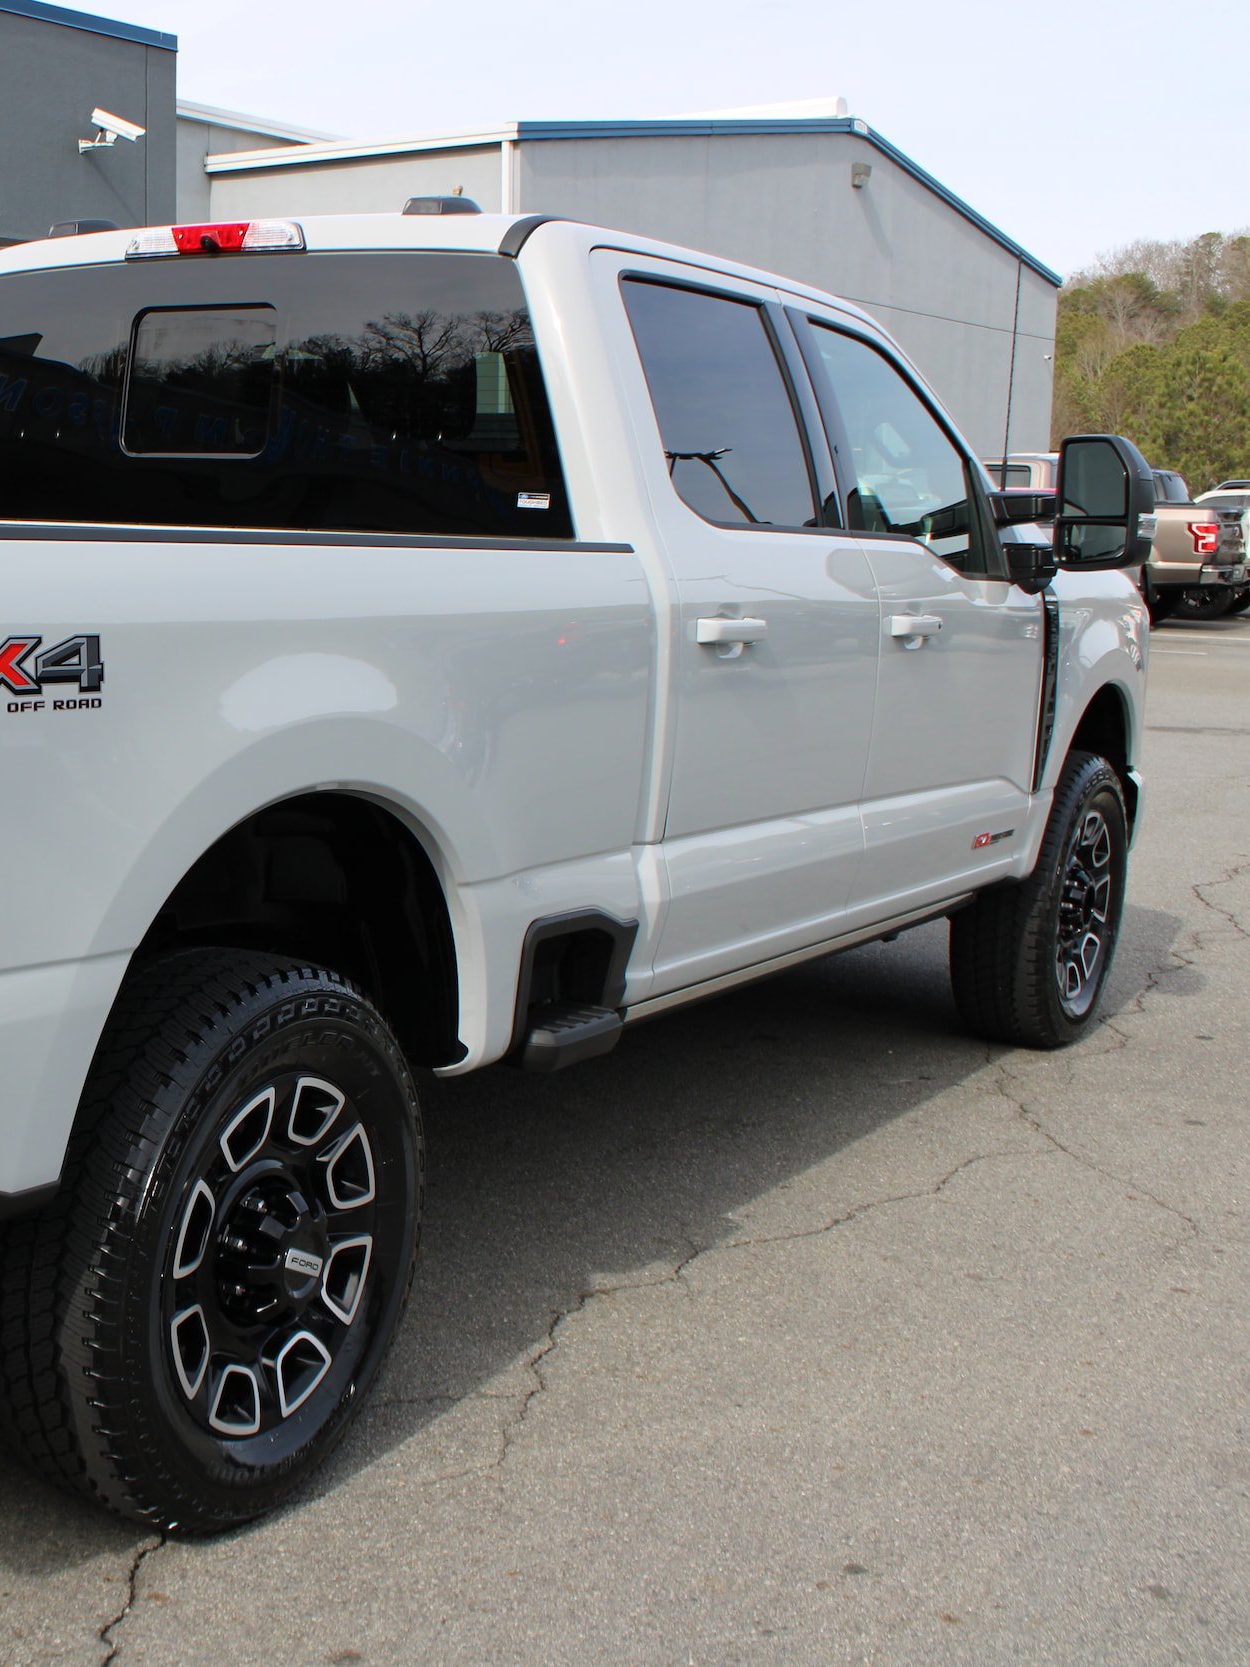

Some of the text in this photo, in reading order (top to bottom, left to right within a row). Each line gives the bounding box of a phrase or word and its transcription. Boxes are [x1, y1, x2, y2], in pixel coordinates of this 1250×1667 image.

[7, 698, 102, 713] OFF ROAD
[290, 1256, 319, 1271] FORD
